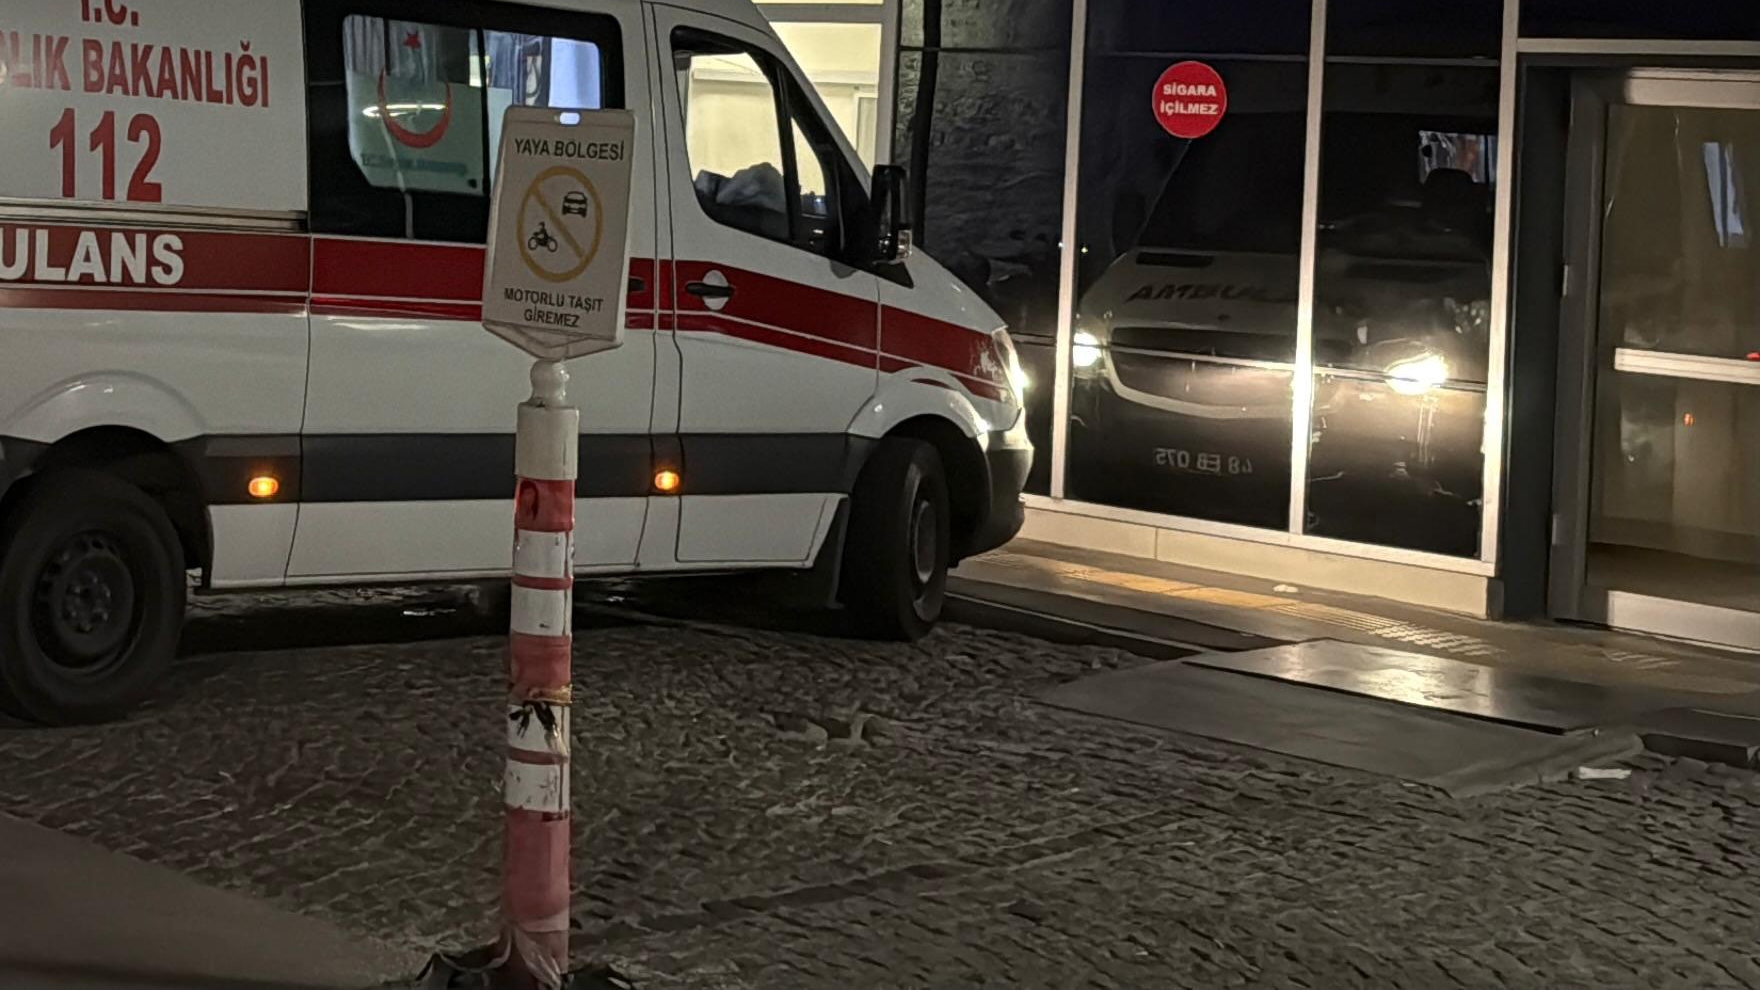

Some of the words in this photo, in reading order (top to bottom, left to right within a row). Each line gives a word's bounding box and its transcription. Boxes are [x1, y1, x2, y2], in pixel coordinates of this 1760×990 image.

[83, 38, 269, 108] BAKANLIĞI
[1163, 82, 1217, 97] SİGARA
[1160, 99, 1219, 116] İÇİLMEZ
[50, 108, 162, 202] 112
[514, 138, 550, 157] YAYA
[504, 287, 565, 308] MOTORLU
[570, 294, 604, 313] TAŞIT
[523, 308, 580, 328] GİREMEZ
